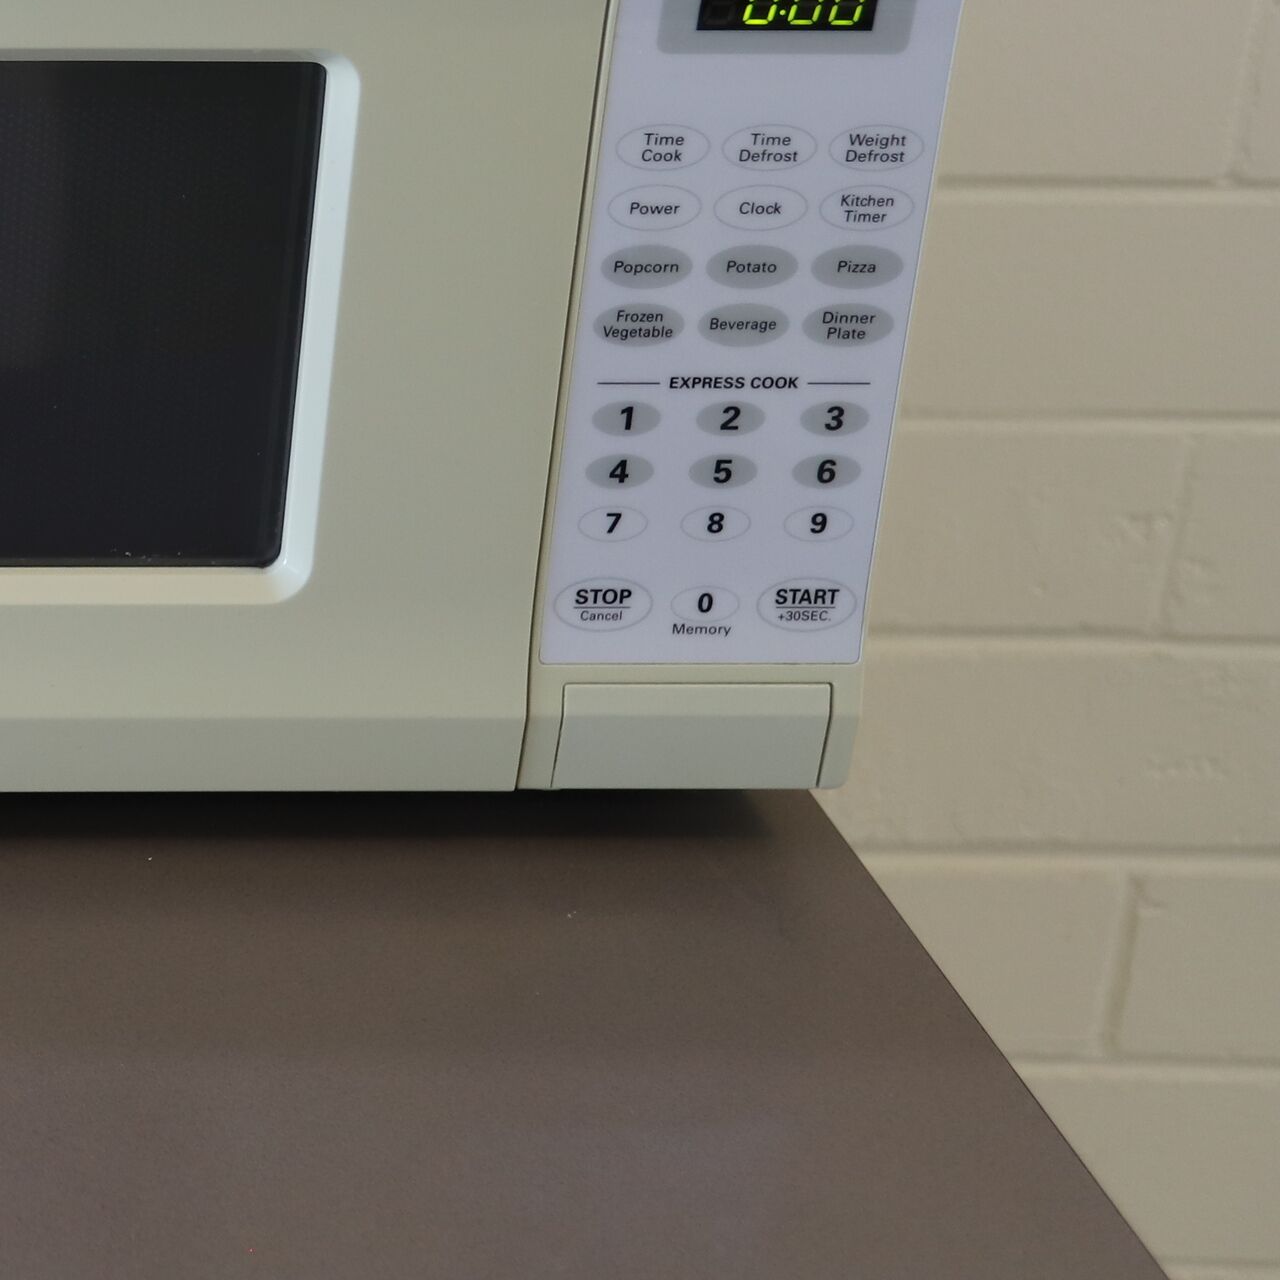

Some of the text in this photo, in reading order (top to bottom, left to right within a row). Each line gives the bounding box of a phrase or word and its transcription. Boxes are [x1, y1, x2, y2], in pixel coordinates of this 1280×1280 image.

[644, 132, 685, 146] Time
[751, 132, 792, 146] Time
[849, 133, 906, 149] Weight
[641, 148, 682, 162] Cook
[739, 149, 798, 162] Defrost
[845, 149, 905, 163] Defrost
[629, 201, 680, 215] Power
[739, 201, 781, 215] Clock
[840, 194, 894, 208] Kitchen
[844, 209, 887, 223] Timer
[613, 260, 679, 276] Popcorn
[726, 260, 777, 274] Potato
[837, 260, 876, 273] Pizza
[616, 309, 664, 323] Frozen
[822, 311, 875, 324] Dinner
[709, 317, 777, 333] Beverage
[603, 325, 673, 341] Vegetable
[826, 326, 866, 340] Plate
[669, 376, 799, 389] EXPRESS COOK
[620, 406, 634, 431] 1
[719, 405, 741, 431] 2
[824, 405, 845, 431] 3
[608, 459, 629, 484] 4
[713, 459, 733, 484] 5
[816, 459, 837, 484] 6
[606, 512, 622, 534] 7
[706, 512, 725, 534] 8
[810, 512, 828, 534] 9
[575, 588, 632, 605] STOP
[697, 592, 714, 614] 0
[775, 588, 840, 605] START
[580, 610, 623, 621] Cancel
[672, 623, 732, 637] Memory
